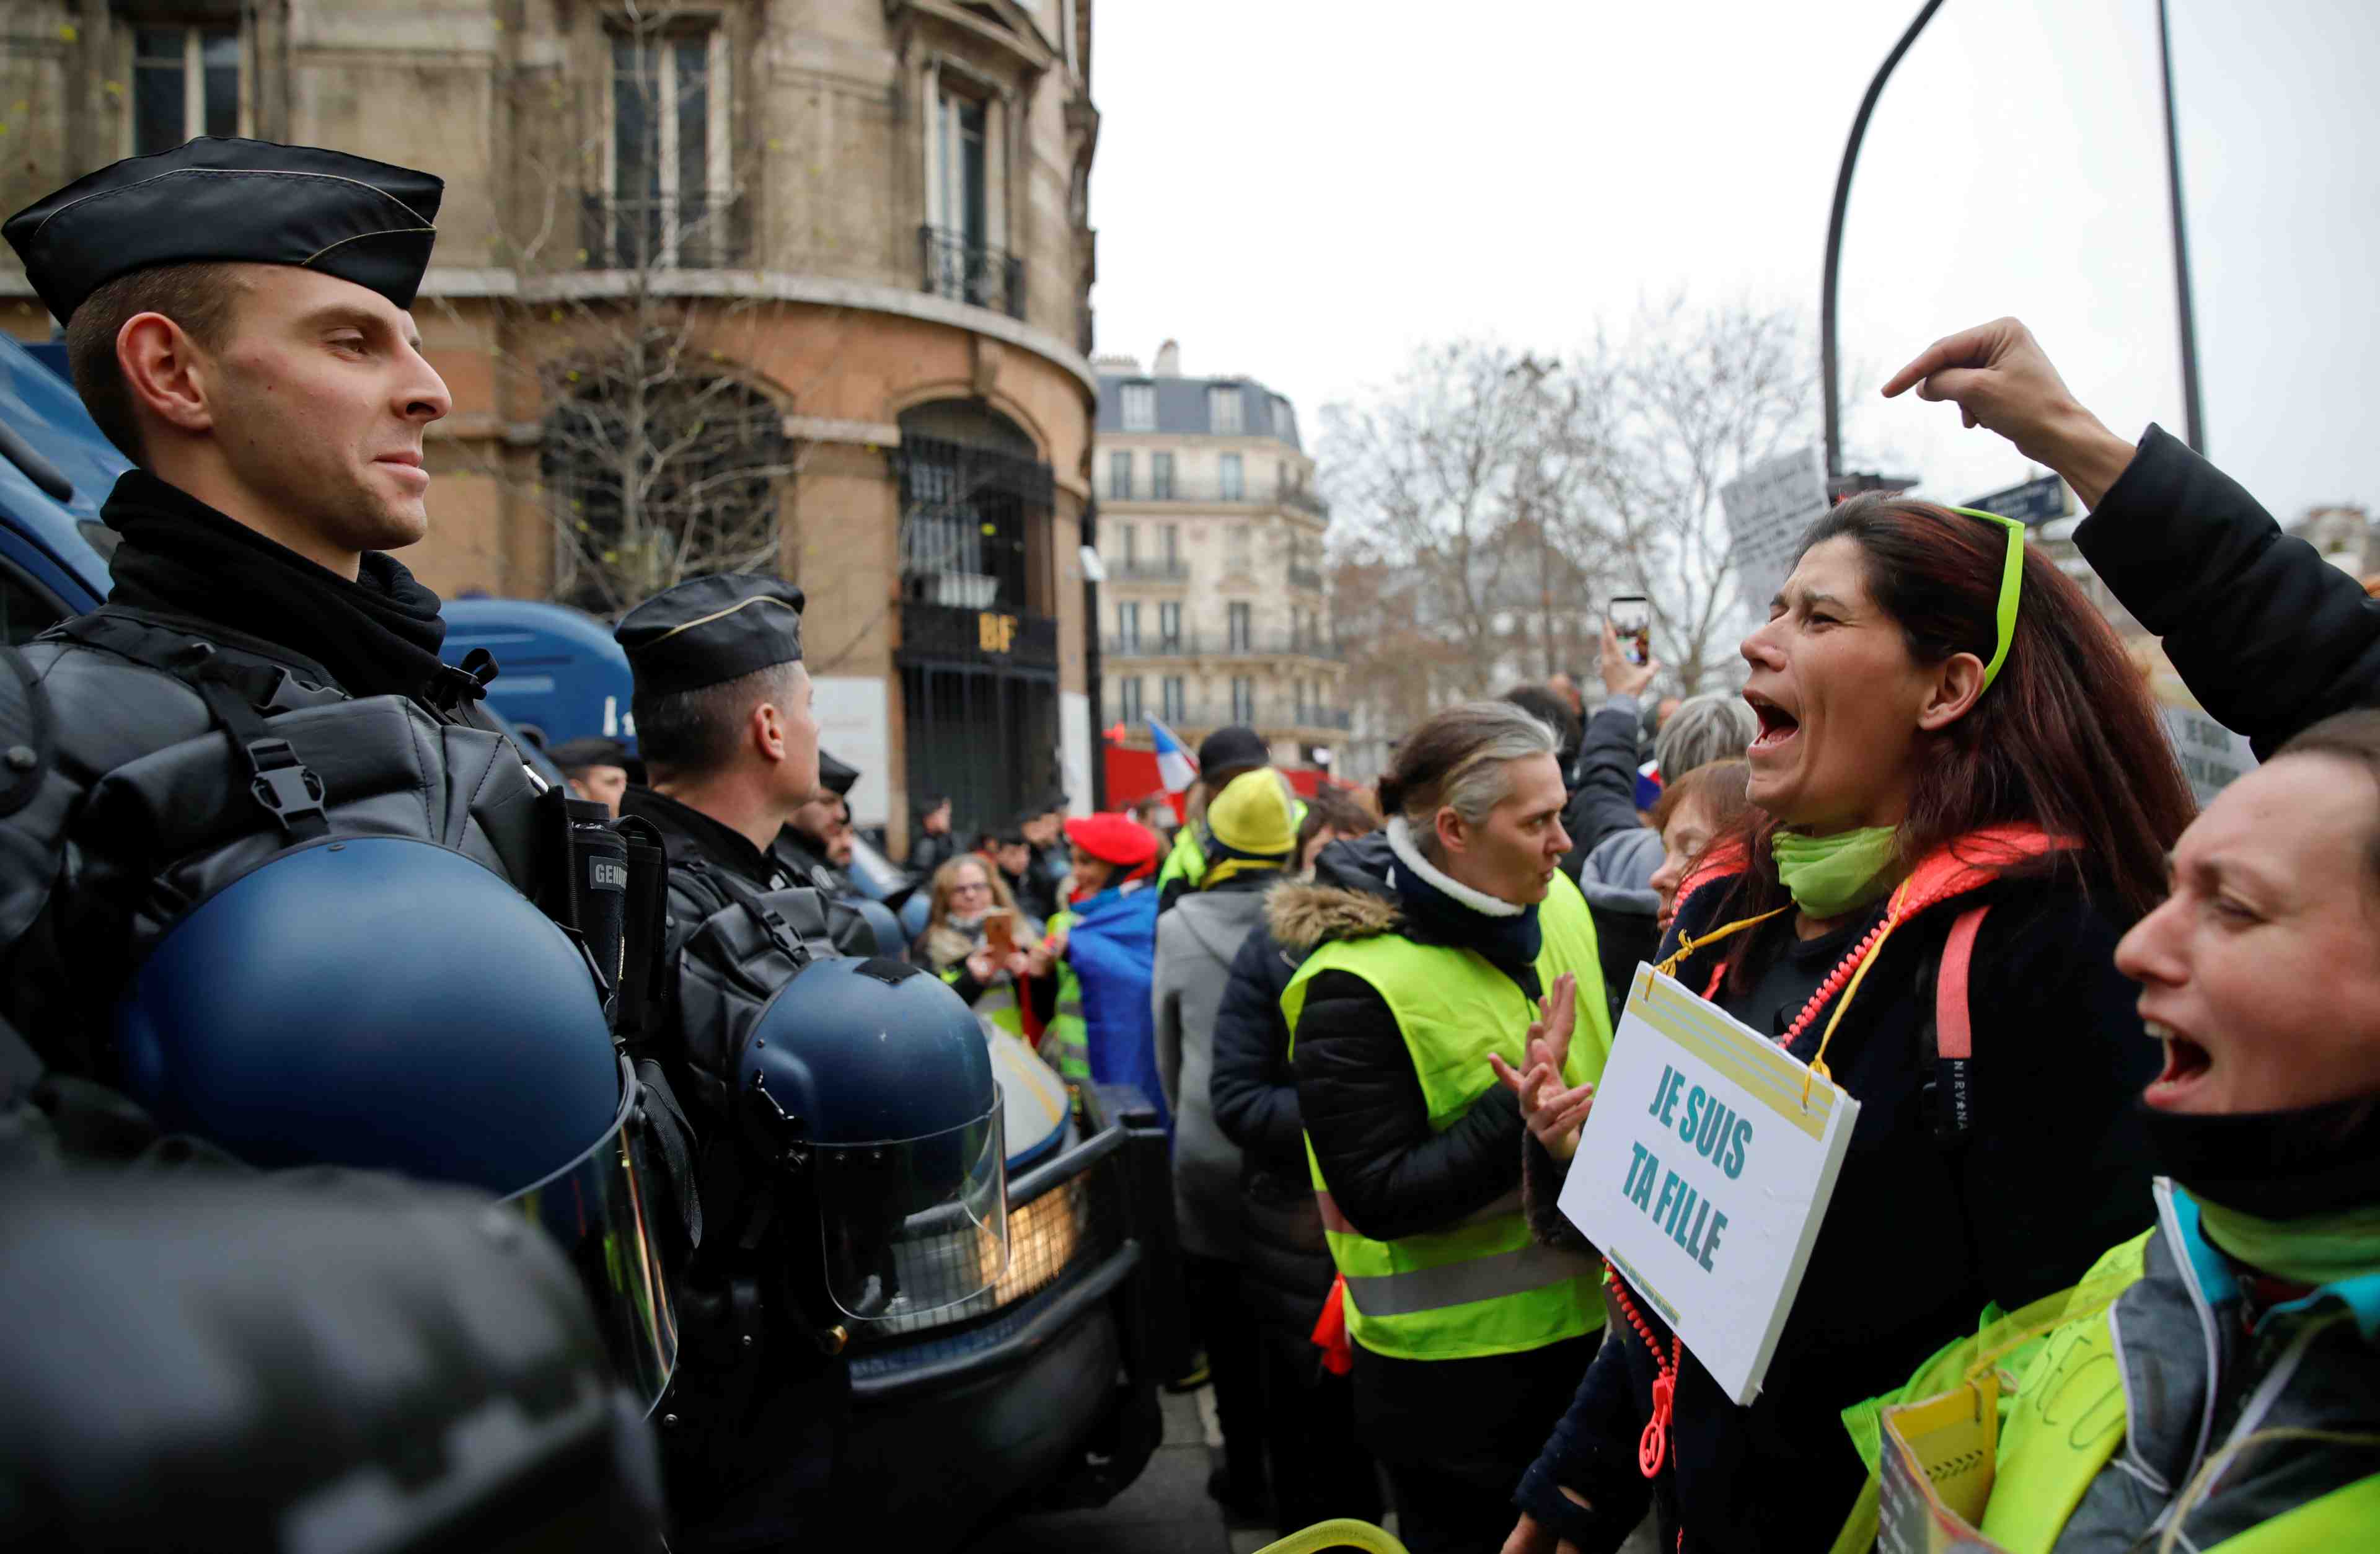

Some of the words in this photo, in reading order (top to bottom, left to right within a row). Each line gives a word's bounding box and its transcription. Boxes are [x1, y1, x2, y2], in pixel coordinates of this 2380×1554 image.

[1649, 1064, 1686, 1129] JE
[1679, 1085, 1753, 1180] SUIS
[1623, 1140, 1659, 1214] TA
[1652, 1169, 1729, 1274] FILLE
